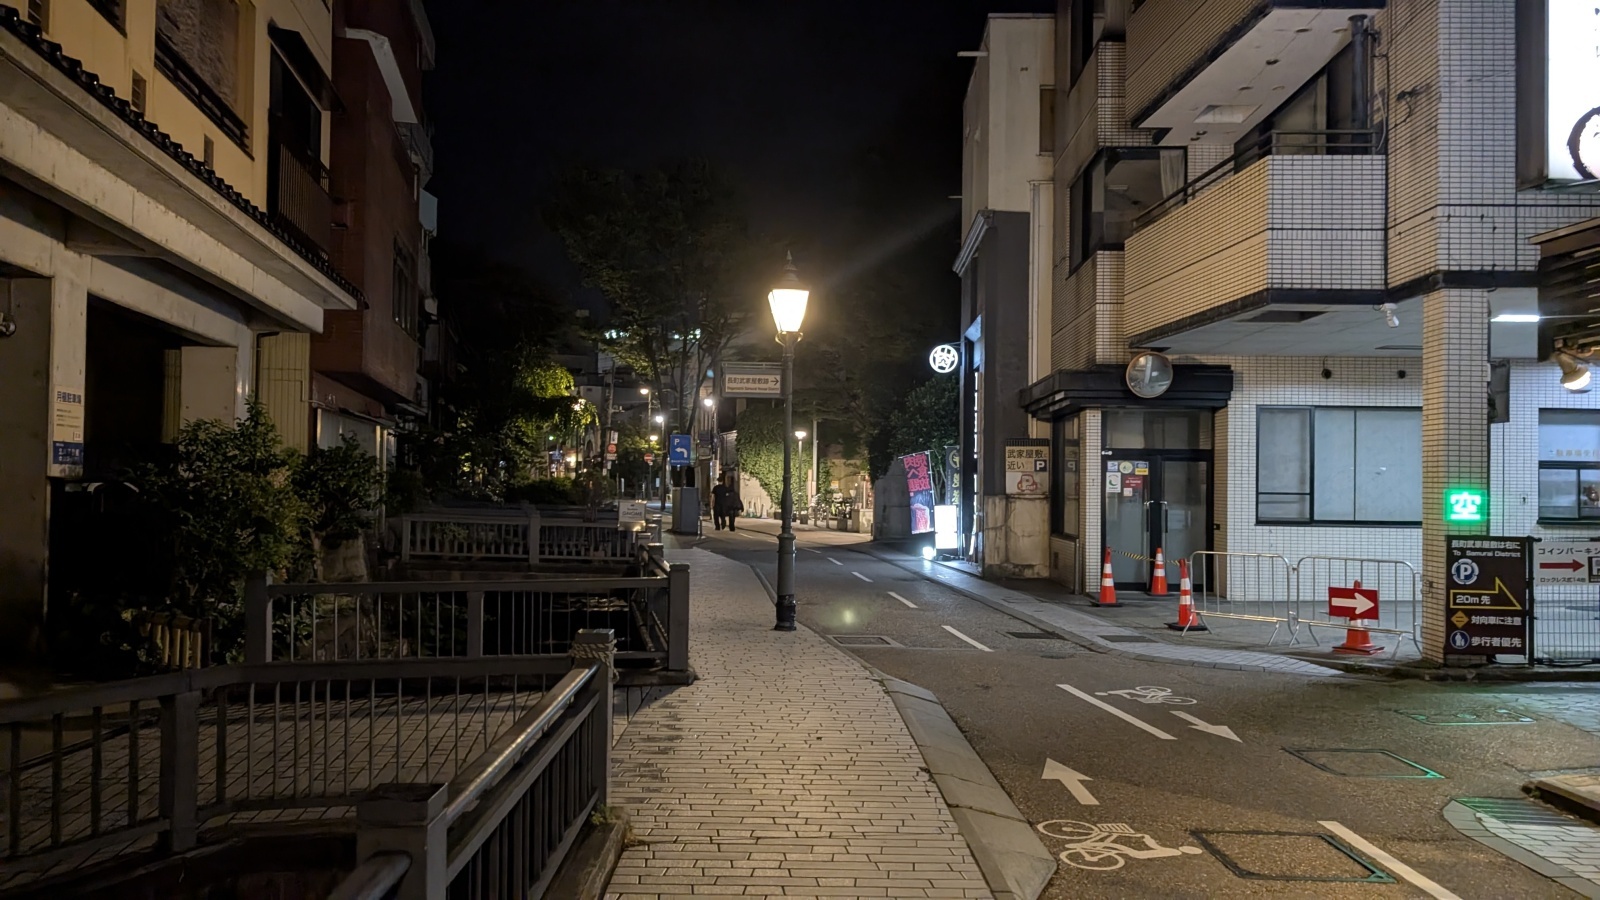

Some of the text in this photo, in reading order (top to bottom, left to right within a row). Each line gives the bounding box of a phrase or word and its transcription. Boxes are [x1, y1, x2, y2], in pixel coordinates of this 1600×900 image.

[1007, 461, 1025, 470] 近い
[1036, 461, 1046, 471] P
[1450, 491, 1482, 520] 空
[1456, 595, 1491, 605] 20m 先
[1471, 616, 1522, 625] 対向車に注意
[1471, 637, 1522, 647] 歩行者優先
